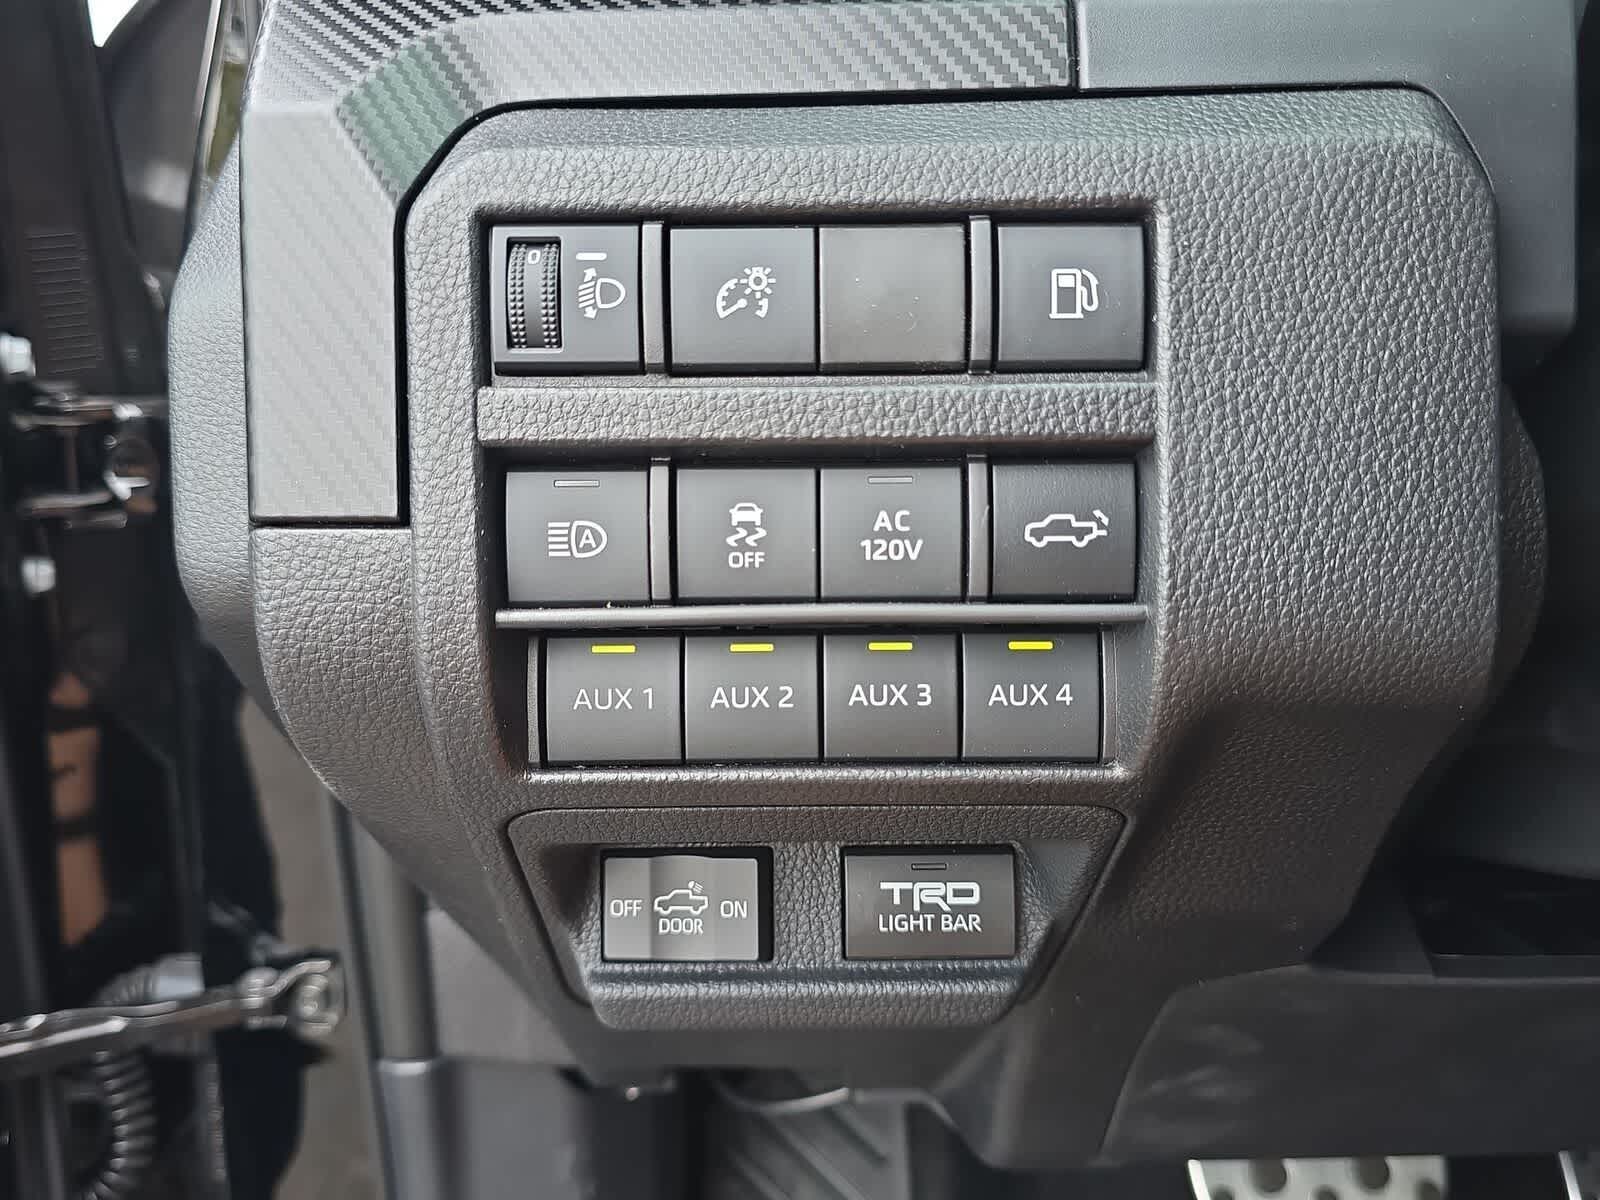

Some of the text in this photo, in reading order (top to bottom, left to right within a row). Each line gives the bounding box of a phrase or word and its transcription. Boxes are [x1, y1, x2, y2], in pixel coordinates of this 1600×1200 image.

[873, 510, 911, 531] AC
[579, 529, 598, 549] A
[728, 550, 766, 569] OFF
[860, 539, 923, 561] 120V
[573, 687, 654, 710] AUX 1
[710, 686, 795, 709] AUX 2
[848, 684, 932, 707] AUX 3
[988, 684, 1074, 707] AUX 4
[879, 881, 981, 911] TRD
[609, 899, 643, 918] OFF
[719, 899, 748, 919] ON
[658, 917, 704, 936] DOOR
[878, 913, 982, 933] LIGHT BAR
